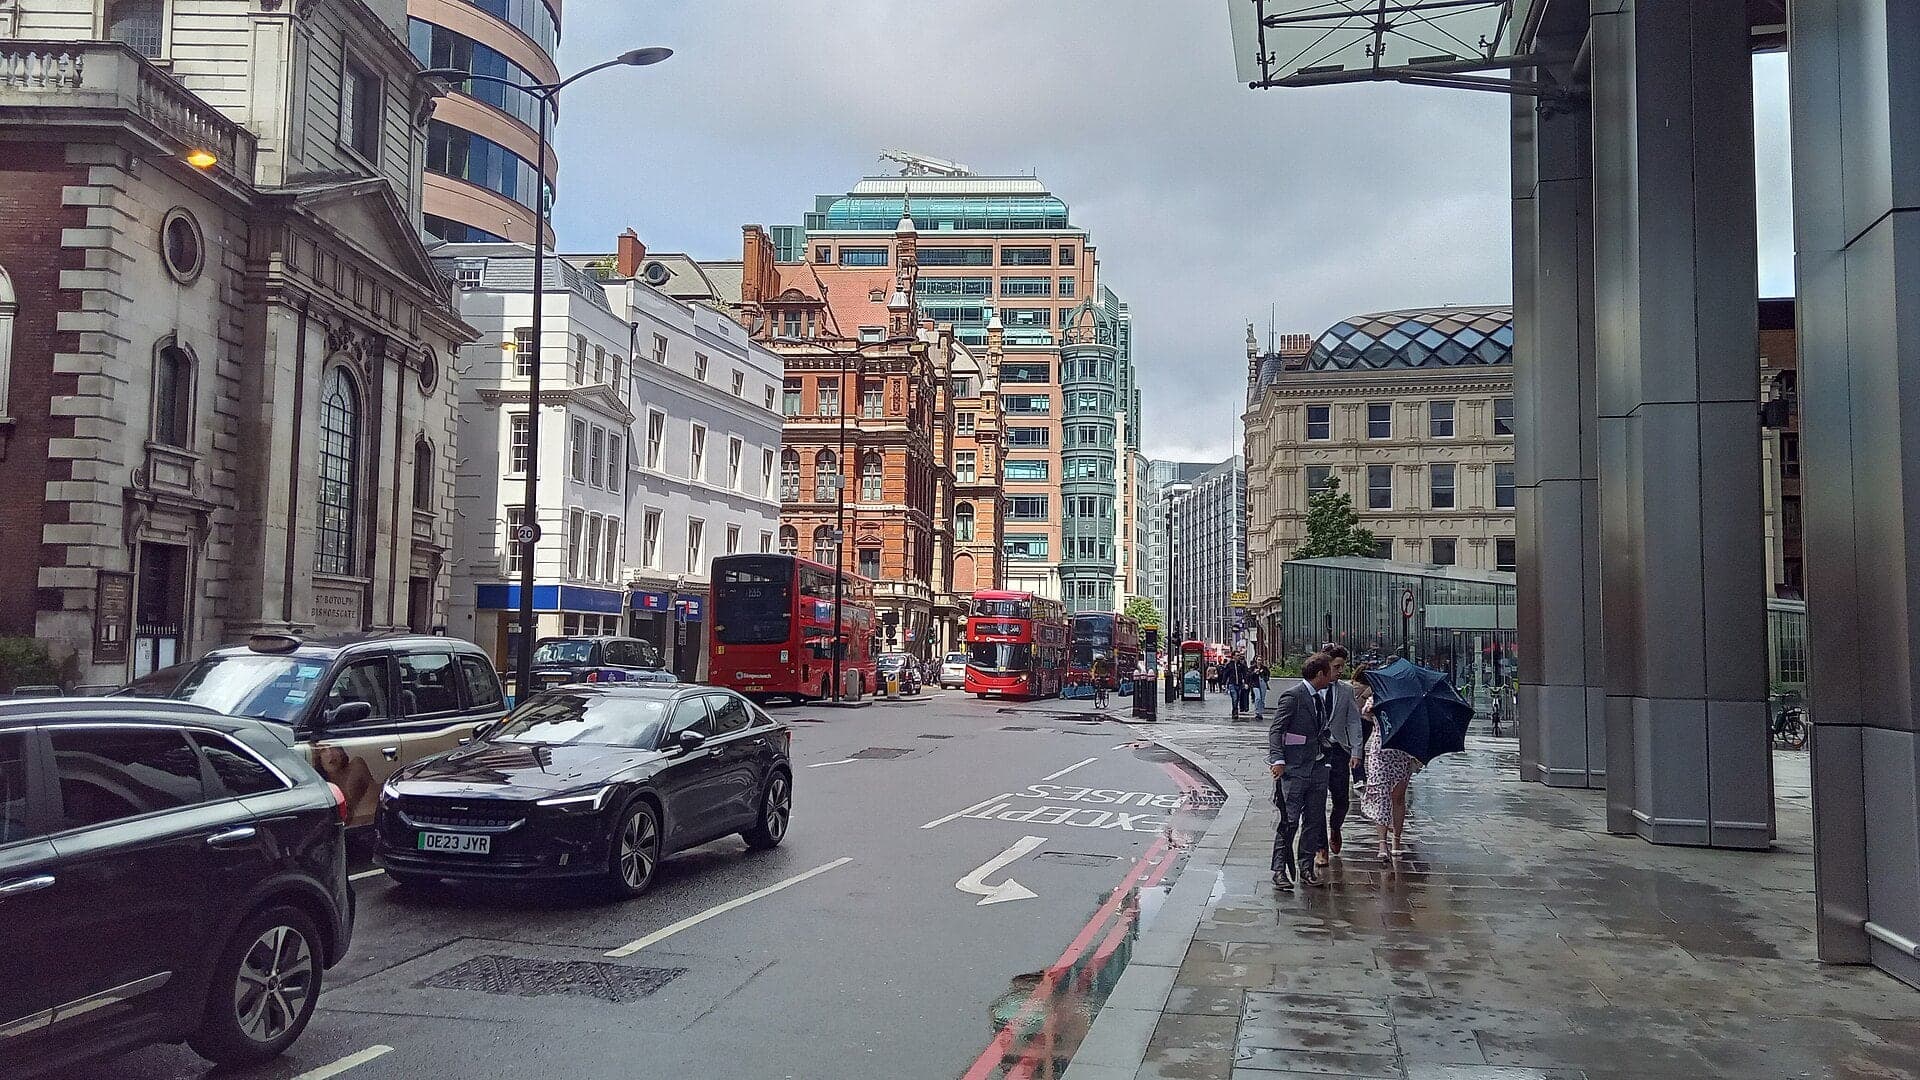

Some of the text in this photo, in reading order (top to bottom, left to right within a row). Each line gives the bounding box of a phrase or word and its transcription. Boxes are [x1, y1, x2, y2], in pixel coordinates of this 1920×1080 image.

[519, 529, 533, 539] 20
[1016, 784, 1189, 808] BUSES
[962, 802, 1169, 833] EXCEPT
[426, 834, 488, 851] OE23 JYR
